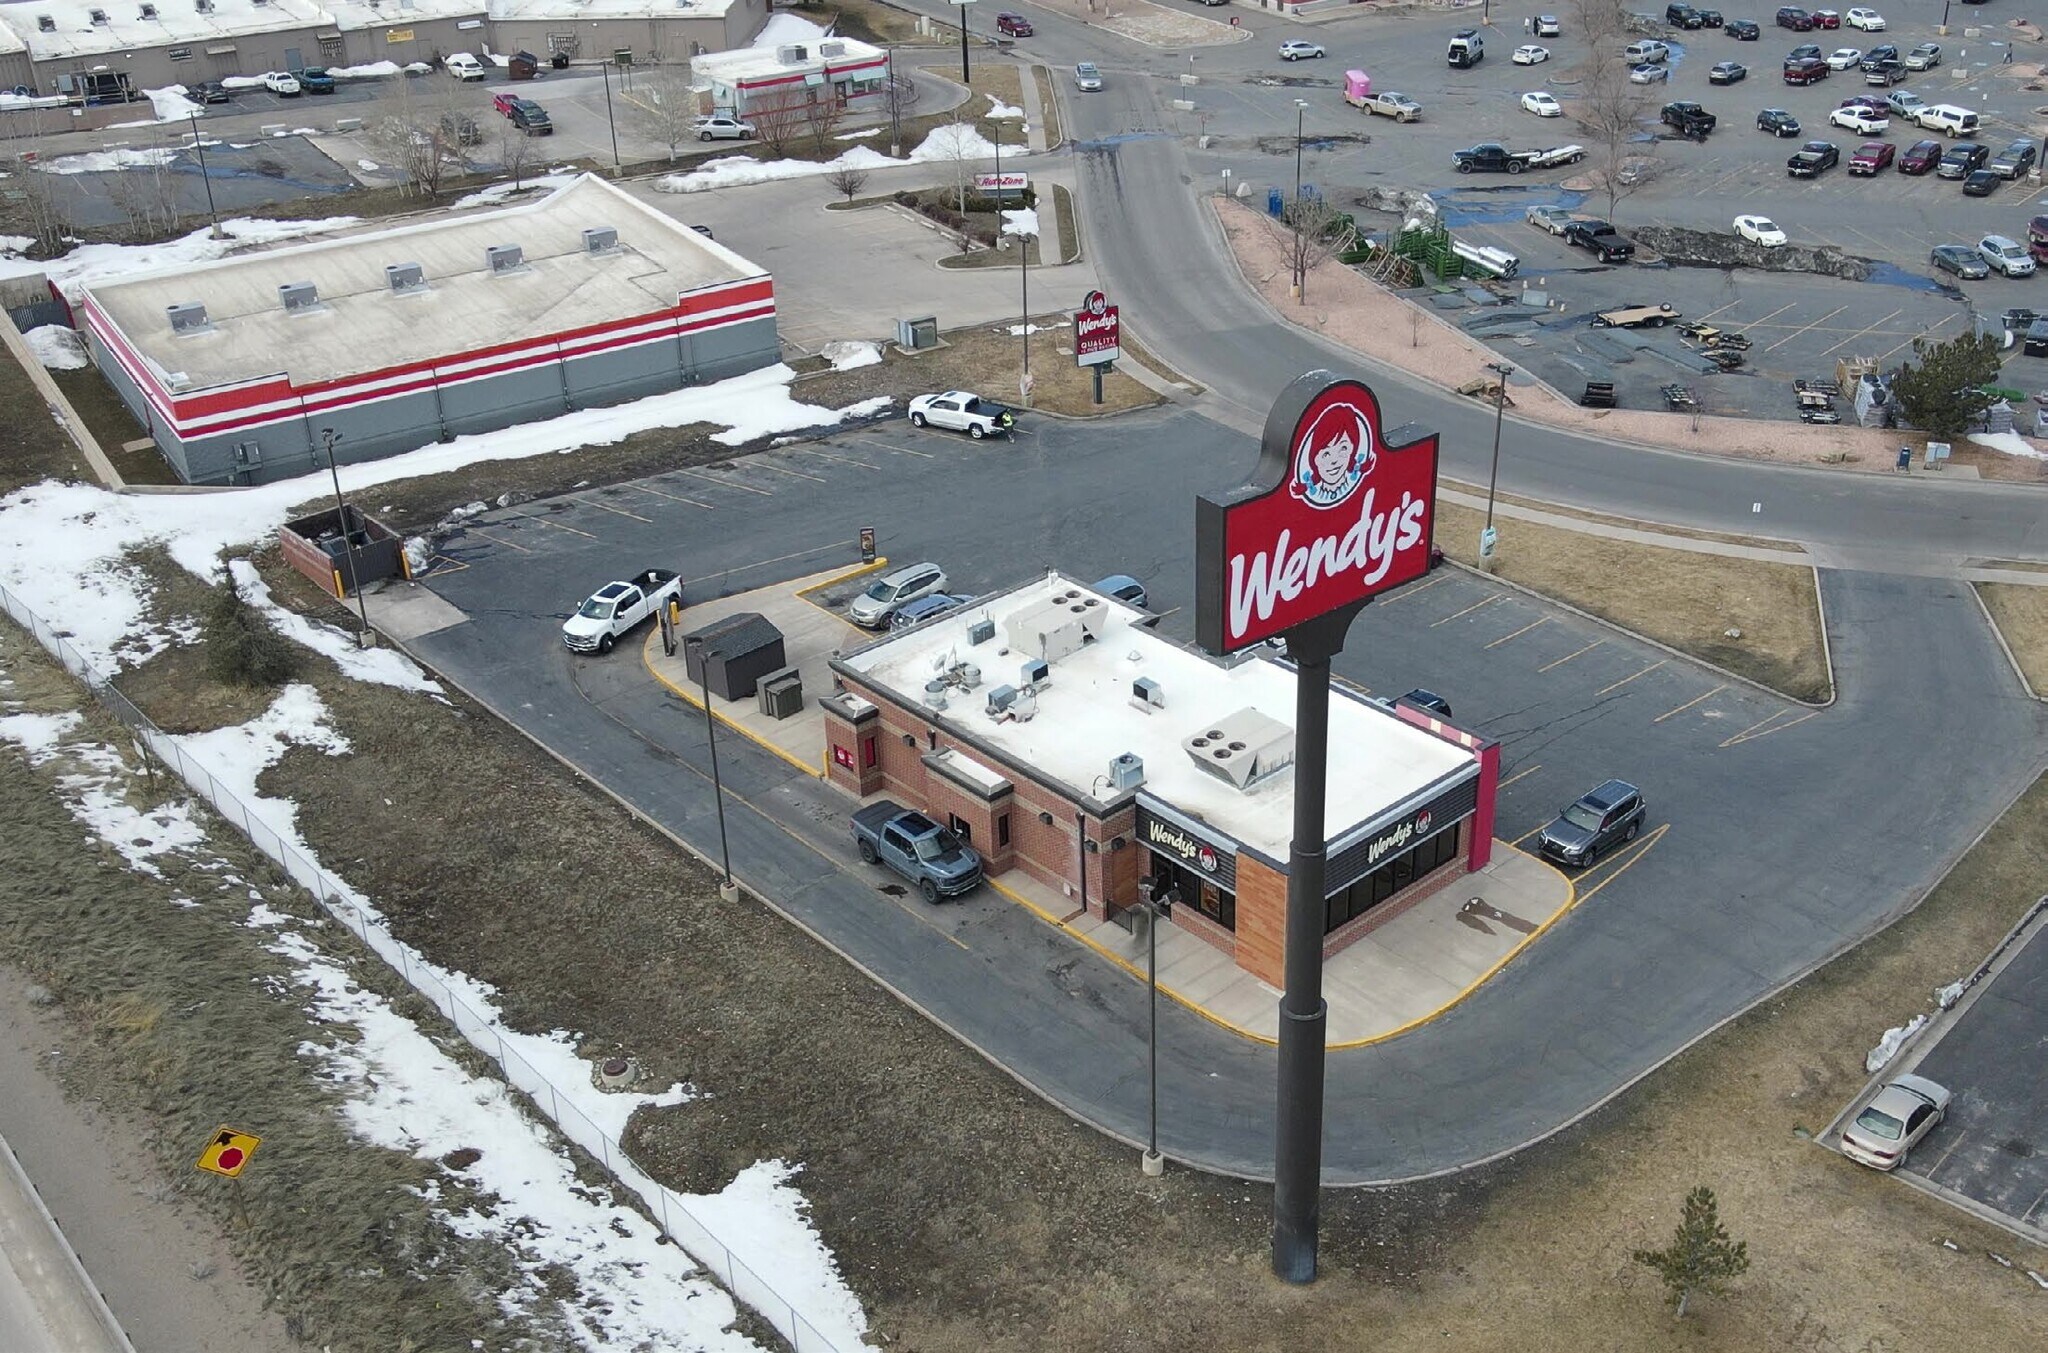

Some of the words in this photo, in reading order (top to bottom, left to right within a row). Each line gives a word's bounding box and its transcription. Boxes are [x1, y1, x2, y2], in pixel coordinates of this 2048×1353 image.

[981, 177, 1024, 186] AutoZone
[1078, 313, 1117, 336] Wendy's
[1081, 336, 1116, 349] QUALITY
[1229, 487, 1424, 639] Wendy's
[1150, 820, 1197, 859] Wendy's
[1367, 822, 1413, 864] Wendy's
